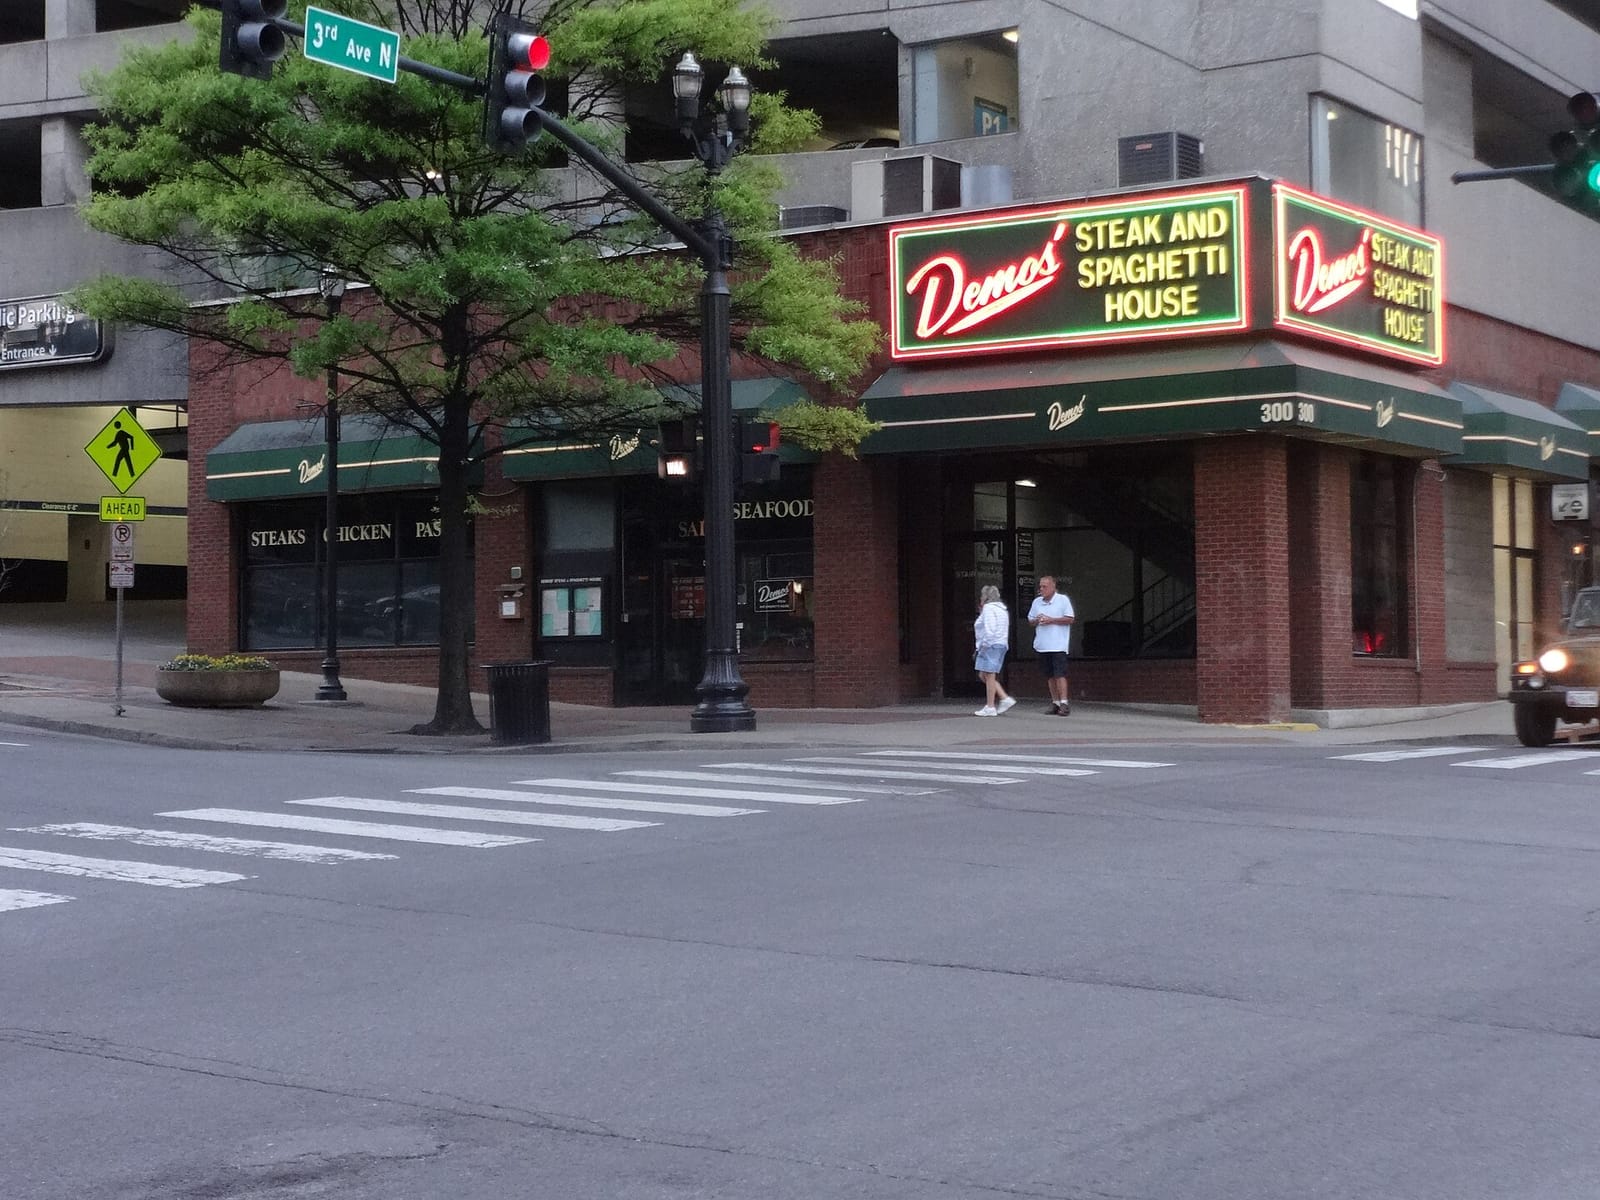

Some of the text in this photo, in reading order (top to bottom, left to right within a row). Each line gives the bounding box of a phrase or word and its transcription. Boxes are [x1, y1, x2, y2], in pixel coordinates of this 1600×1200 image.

[312, 22, 391, 69] 3rd Ave N
[982, 111, 1000, 136] P1
[1076, 207, 1228, 252] STEAK AND
[1077, 245, 1228, 289] SPAGHETTI
[1371, 232, 1434, 278] STEAK AND
[906, 221, 1068, 339] Demos'
[18, 302, 75, 325] Parking
[1104, 285, 1199, 323] HOUSE
[1384, 307, 1425, 343] HOUSE
[1, 346, 46, 361] Entrance
[1261, 402, 1315, 423] 300 300
[106, 503, 140, 515] AHEAD
[251, 529, 306, 547] STEAKS
